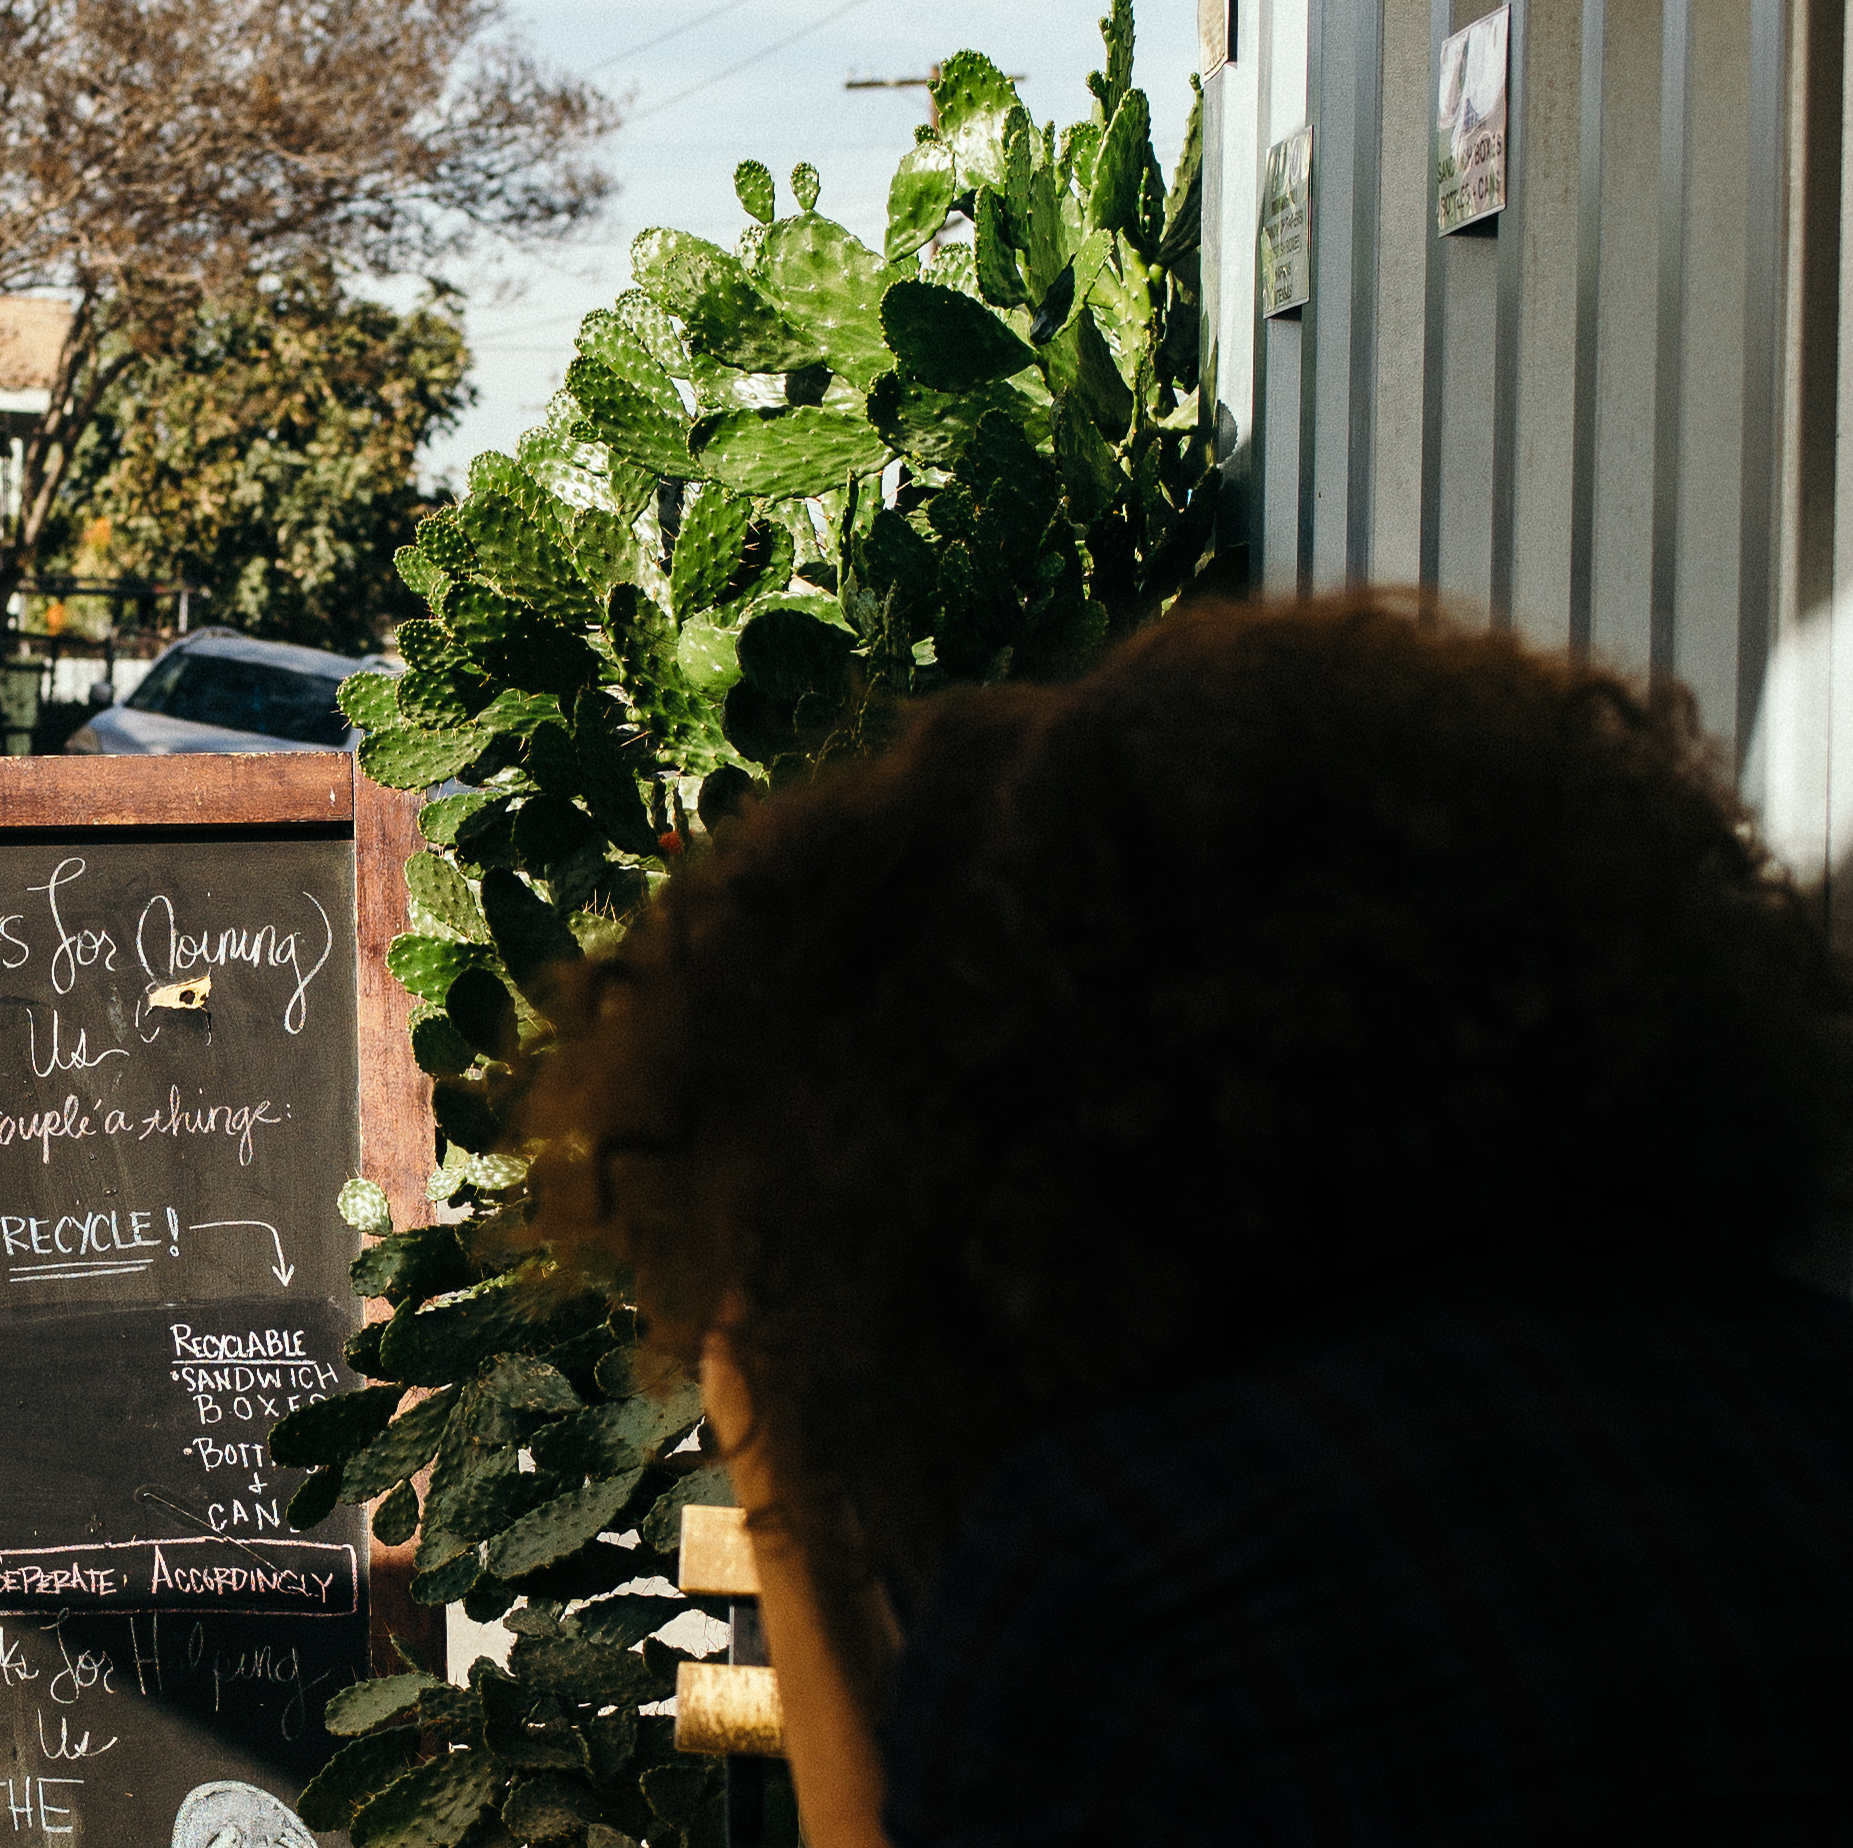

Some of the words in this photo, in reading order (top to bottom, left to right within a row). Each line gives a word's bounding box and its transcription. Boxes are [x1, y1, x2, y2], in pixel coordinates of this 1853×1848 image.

[26, 857, 117, 995] for
[26, 1008, 130, 1078] Us
[169, 1323, 307, 1360] RECYCLABLE
[181, 1362, 339, 1393] SANDWICH
[207, 1498, 301, 1534] CAN
[39, 1607, 118, 1705] for
[36, 1708, 119, 1760] Us
